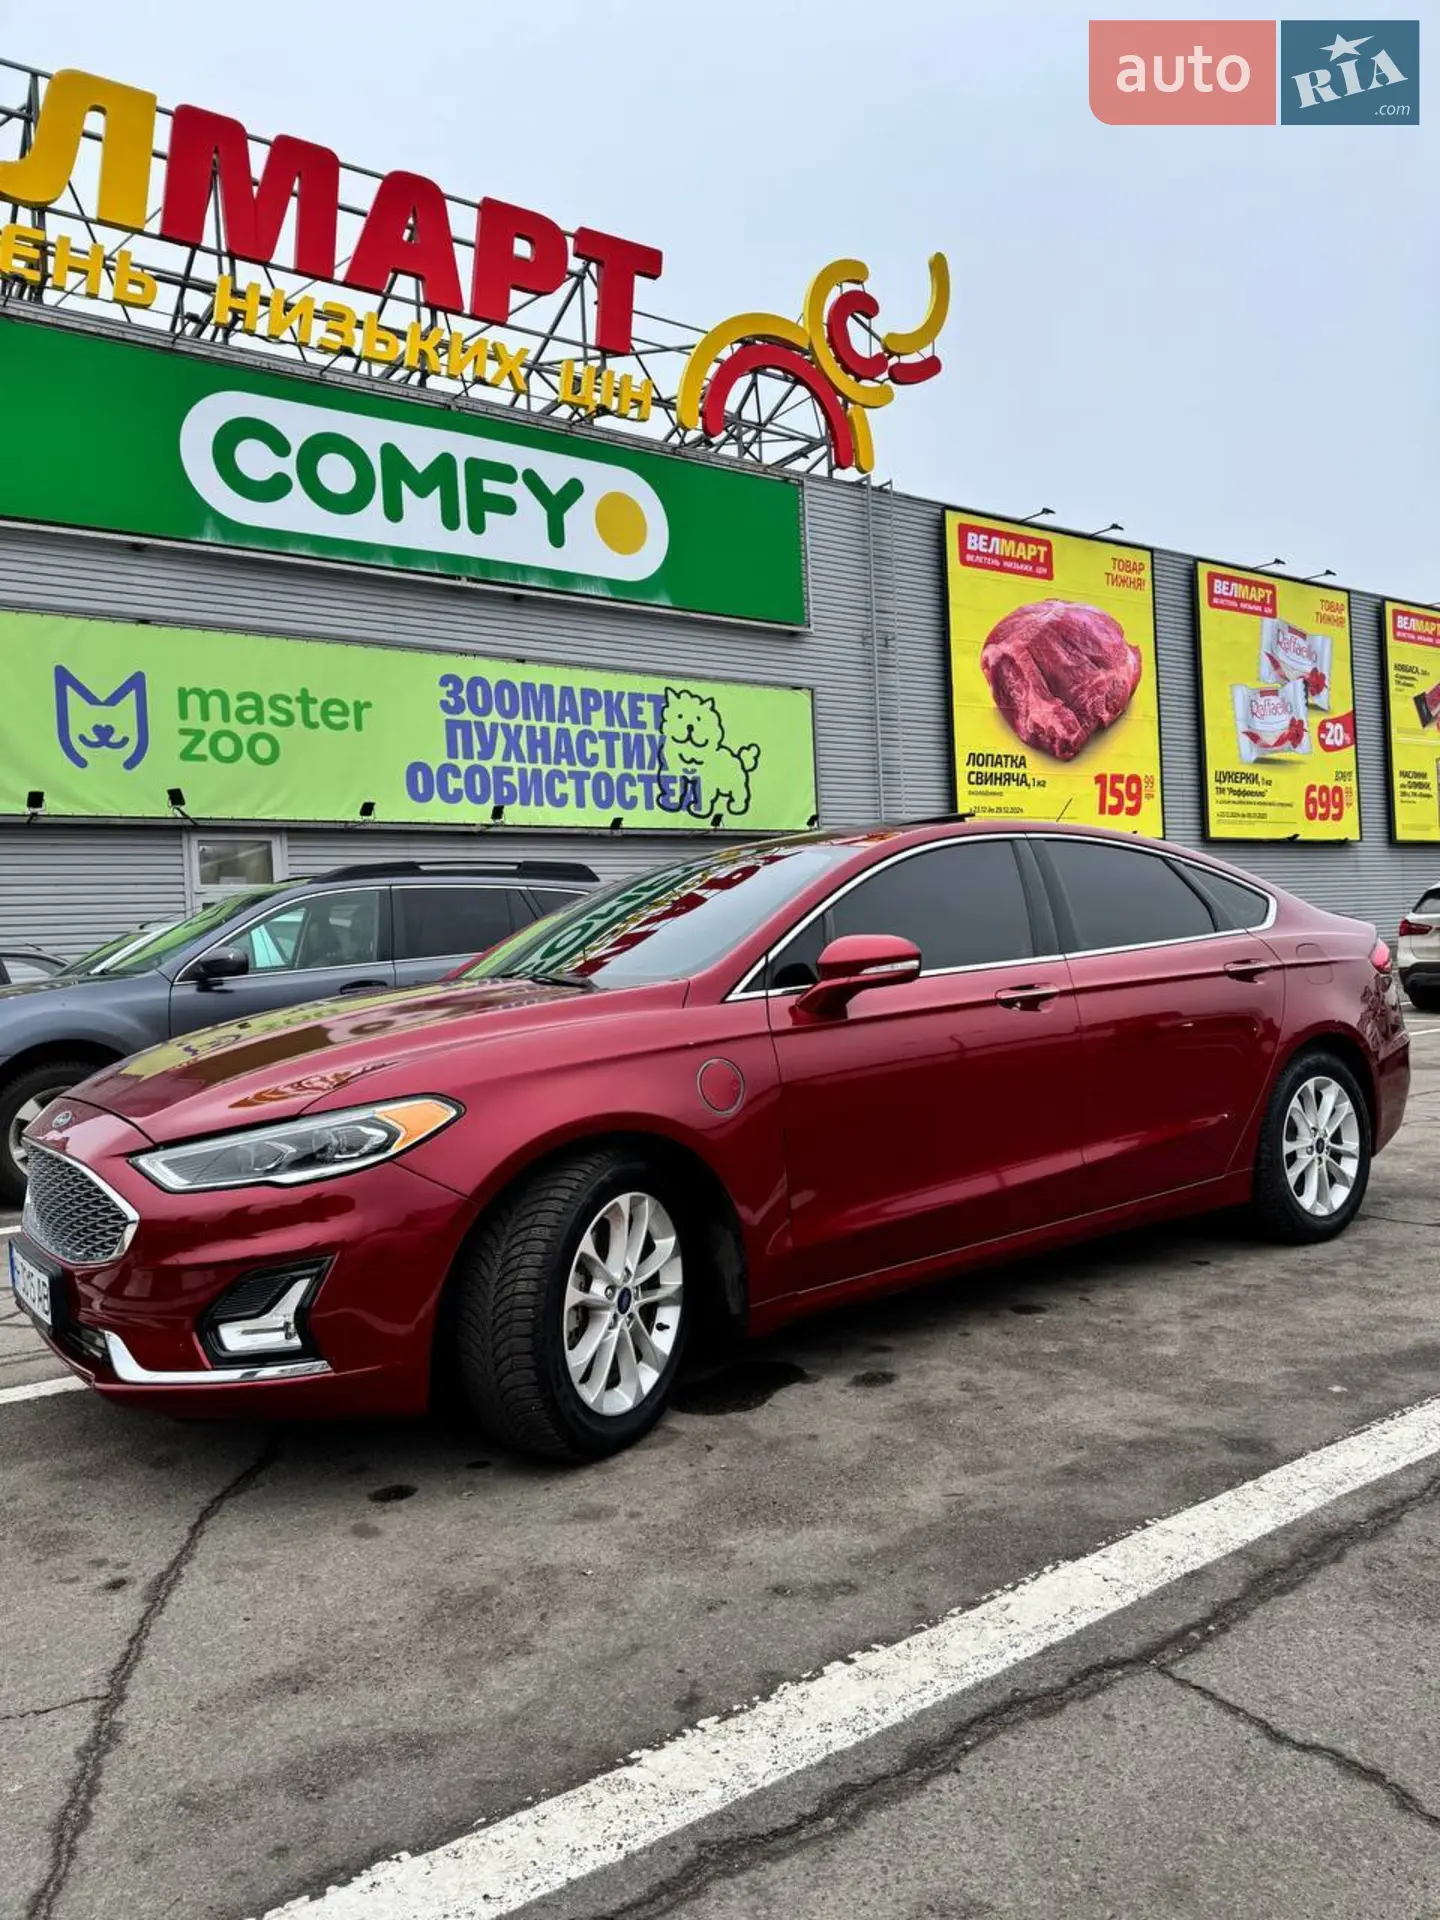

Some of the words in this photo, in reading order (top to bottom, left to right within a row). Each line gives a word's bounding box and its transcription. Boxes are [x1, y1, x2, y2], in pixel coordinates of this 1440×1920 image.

[213, 275, 530, 394] НИЗЬКИХ
[557, 360, 653, 422] ЦІН
[212, 416, 584, 549] COMFY
[967, 532, 1048, 563] ВЕЛМАРТ
[1111, 557, 1146, 575] ТОВАР
[1104, 572, 1146, 592] ТИЖНЯ!
[1213, 579, 1273, 604] ВЕЛМАРТ
[1320, 599, 1345, 614] ТОВАР
[178, 685, 373, 733] master
[438, 673, 667, 731] ЗООМАРКЕТ
[179, 727, 281, 767] zoo
[445, 718, 669, 771] ПУХНАСТИХ
[966, 752, 1027, 768] ЛОПАТКА
[405, 761, 702, 812] ОСОБИСТОСТЕЙ
[967, 771, 1031, 789] СВИНЯЧА,
[1031, 777, 1036, 787] 1
[1094, 772, 1142, 817] 159
[1304, 783, 1345, 822] 699
